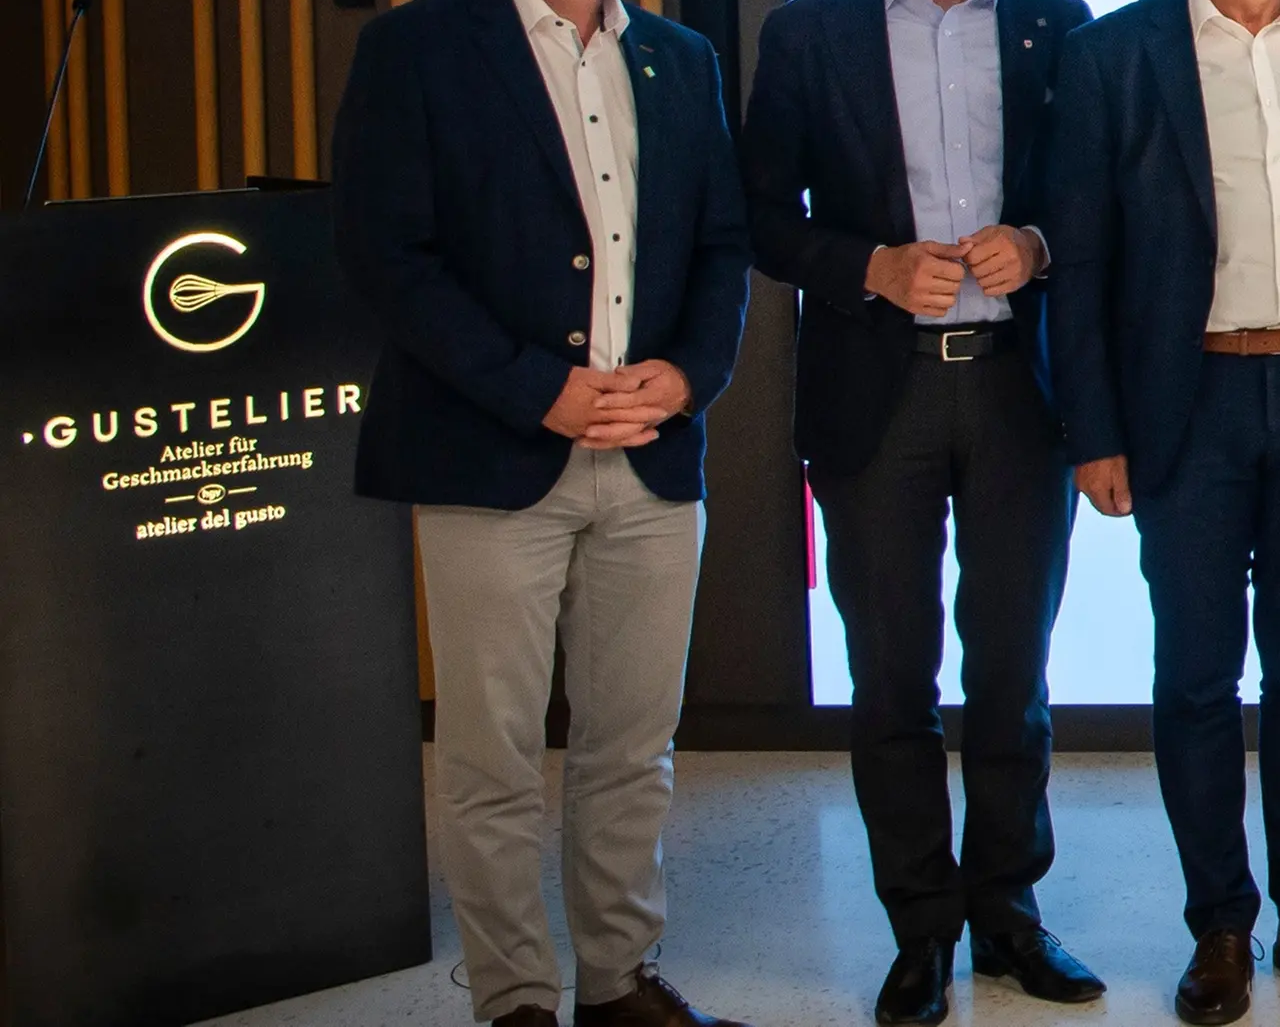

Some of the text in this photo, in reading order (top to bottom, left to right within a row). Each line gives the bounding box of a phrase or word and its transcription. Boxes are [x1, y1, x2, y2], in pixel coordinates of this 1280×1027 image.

[43, 383, 362, 449] GUSTELIER
[160, 435, 258, 463] Atelier für
[102, 450, 313, 491] Geschmackserfahrung
[135, 503, 286, 540] atelier del gusto
